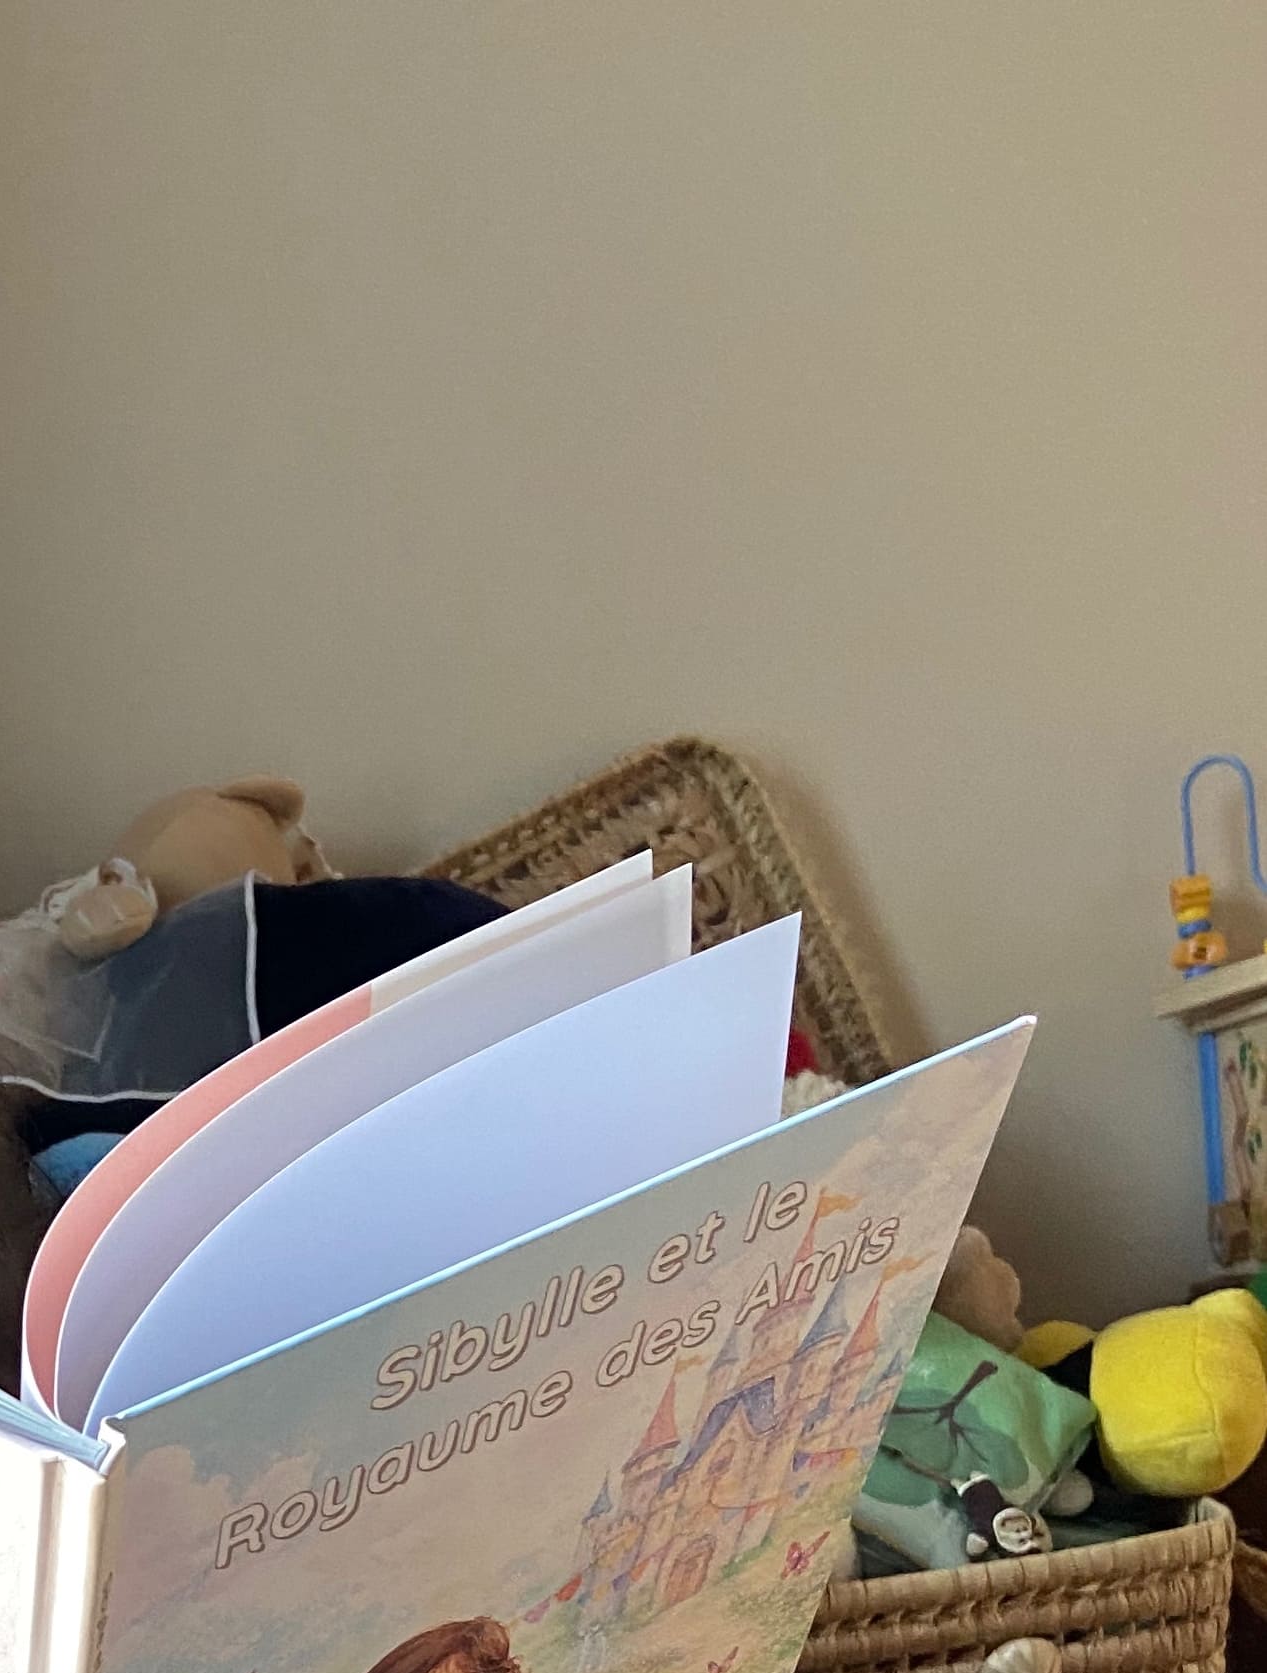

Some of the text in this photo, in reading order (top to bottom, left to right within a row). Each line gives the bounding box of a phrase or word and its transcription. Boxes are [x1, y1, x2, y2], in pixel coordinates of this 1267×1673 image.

[215, 1216, 899, 1569] Royaume des Amis
[370, 1181, 808, 1410] Sibylle et le
